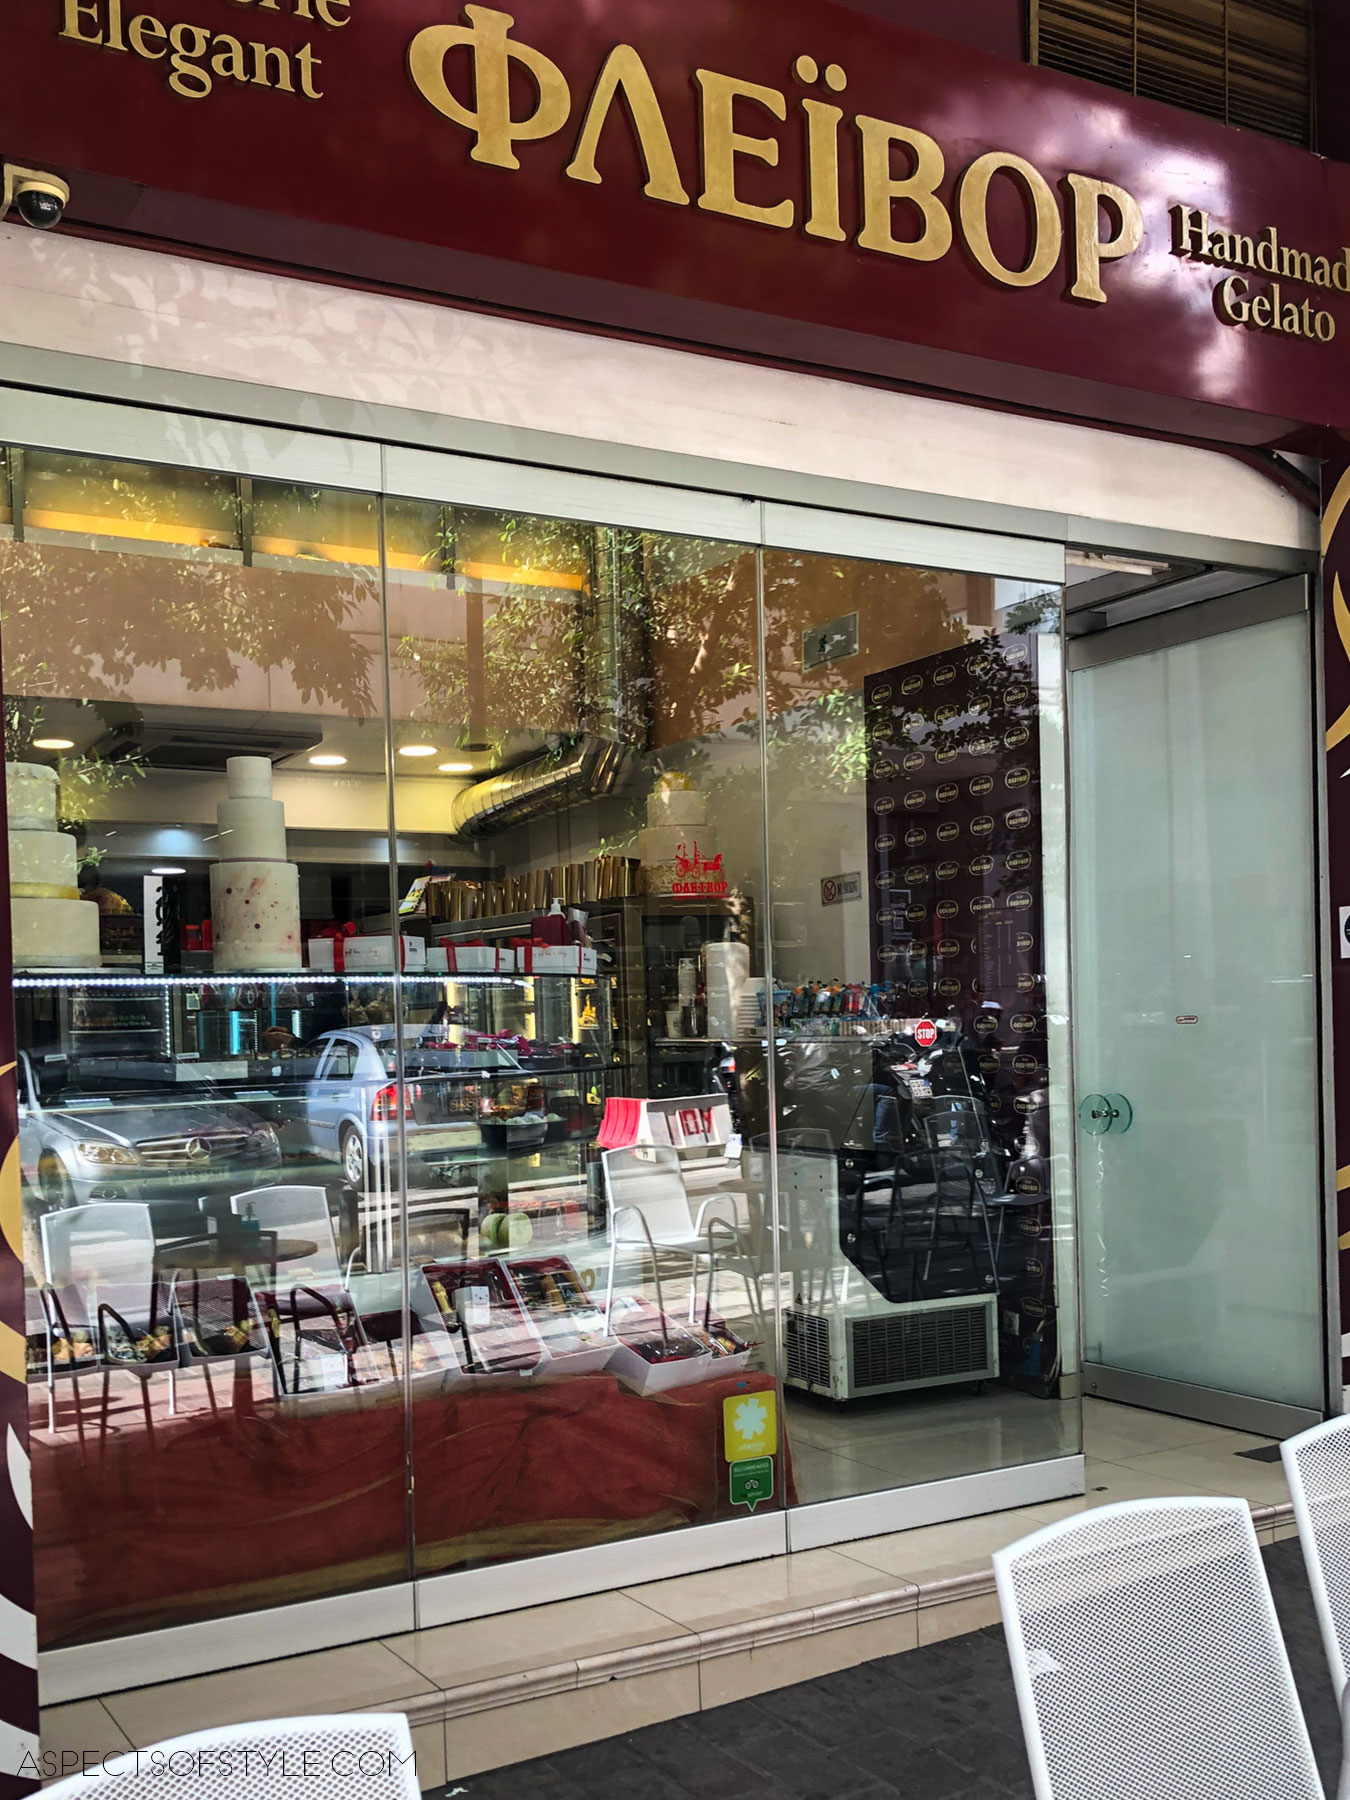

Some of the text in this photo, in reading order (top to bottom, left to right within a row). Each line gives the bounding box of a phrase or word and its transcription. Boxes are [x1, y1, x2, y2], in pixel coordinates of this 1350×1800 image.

[58, 0, 324, 99] Elegant
[409, 3, 1143, 303] ΦΛΕΪΒΟΡ
[1222, 274, 1336, 342] Gelato
[917, 1028, 935, 1039] STOP
